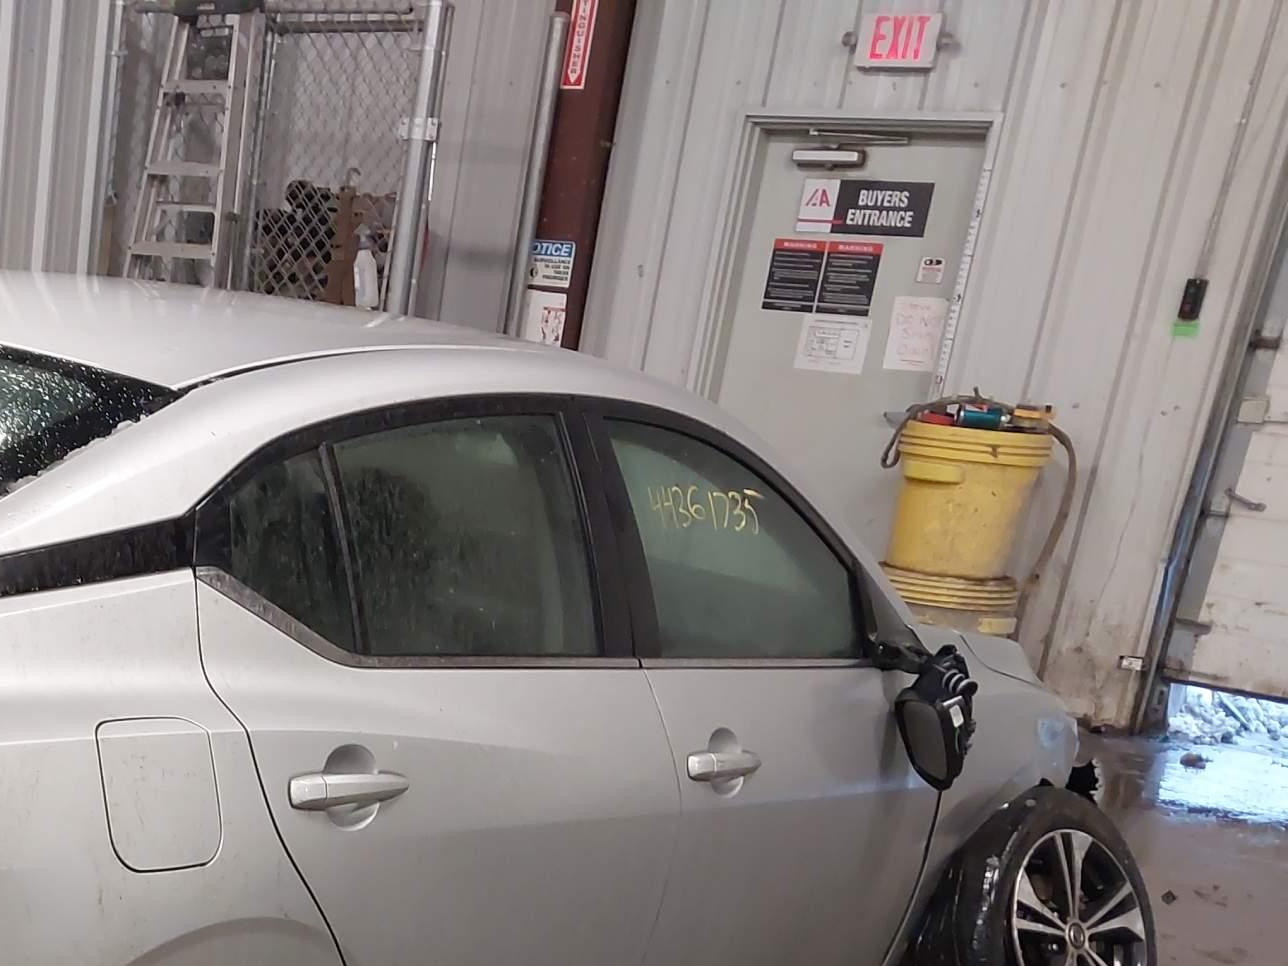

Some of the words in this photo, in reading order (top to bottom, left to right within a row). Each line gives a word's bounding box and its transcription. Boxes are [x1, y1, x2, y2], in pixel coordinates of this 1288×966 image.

[869, 15, 931, 60] EXIT
[858, 189, 910, 208] BUYERS
[845, 208, 914, 228] ENTRANCE
[532, 242, 571, 256] OTICE
[648, 485, 765, 534] 44361735
